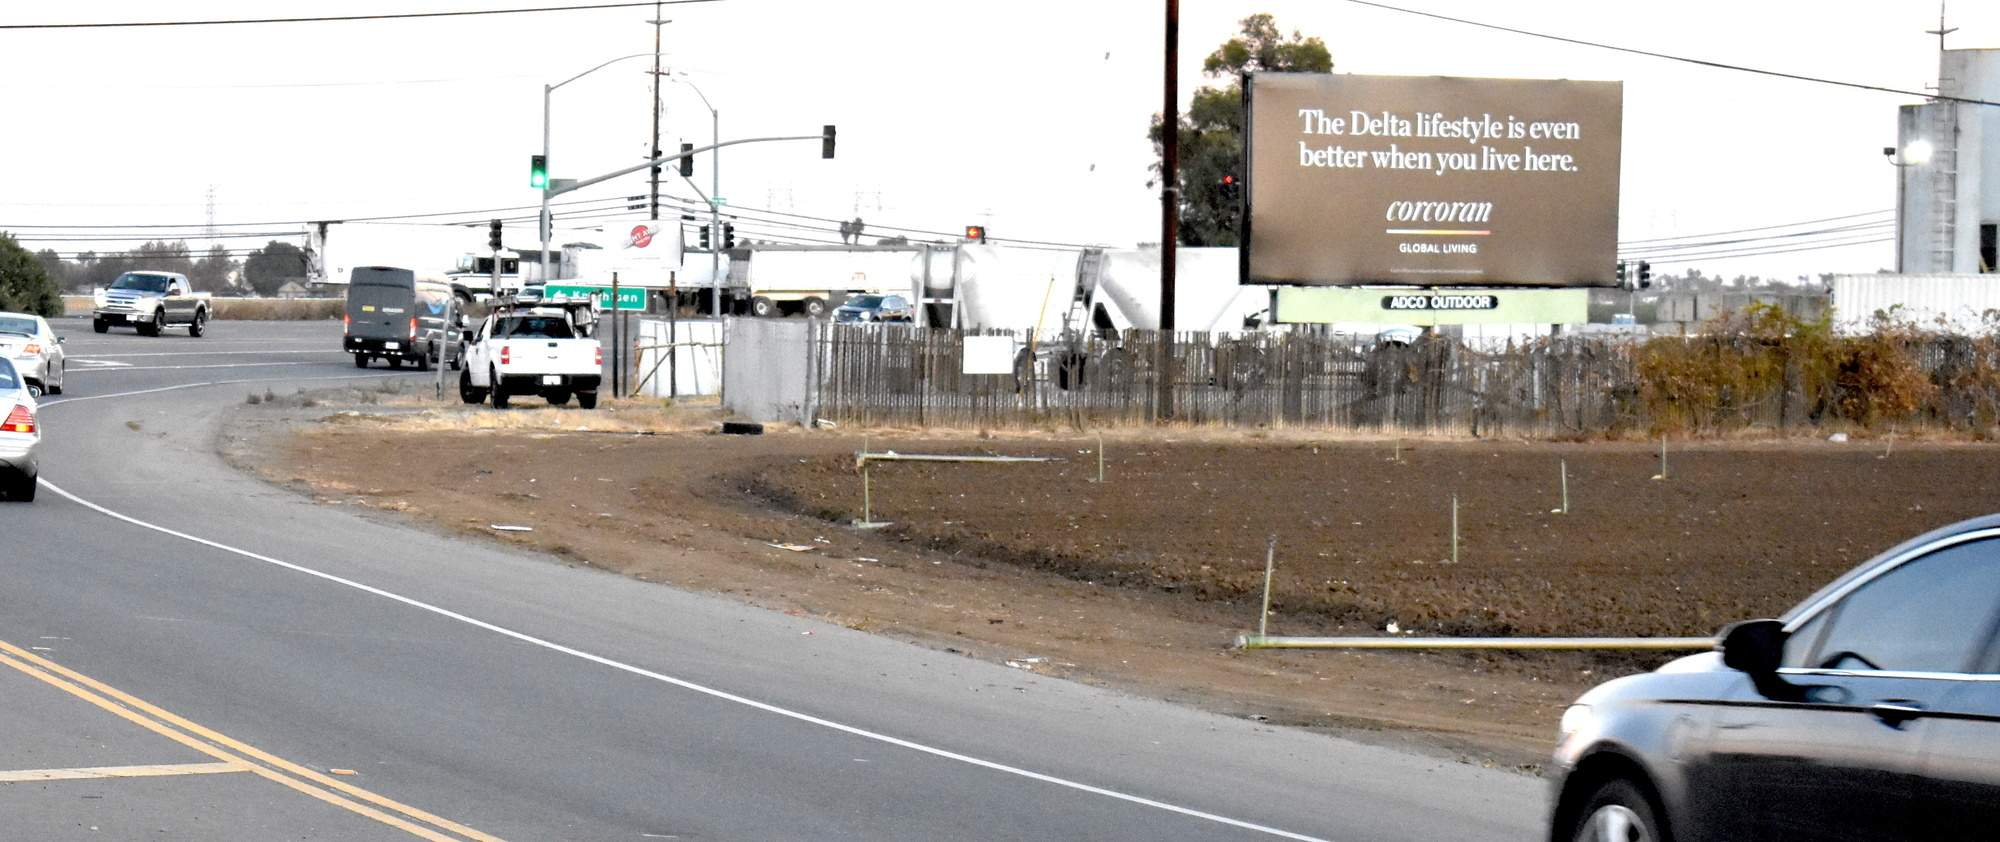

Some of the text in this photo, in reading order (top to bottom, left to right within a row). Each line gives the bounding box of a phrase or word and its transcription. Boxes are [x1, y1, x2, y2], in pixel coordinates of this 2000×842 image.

[1299, 108, 1580, 144] The Delta lifestyle is even
[1299, 141, 1578, 176] better when you live here.
[1386, 200, 1492, 222] corcoran
[1399, 243, 1477, 253] GLOBAL LIVING
[1391, 296, 1490, 309] ADCO OUTDOOR
